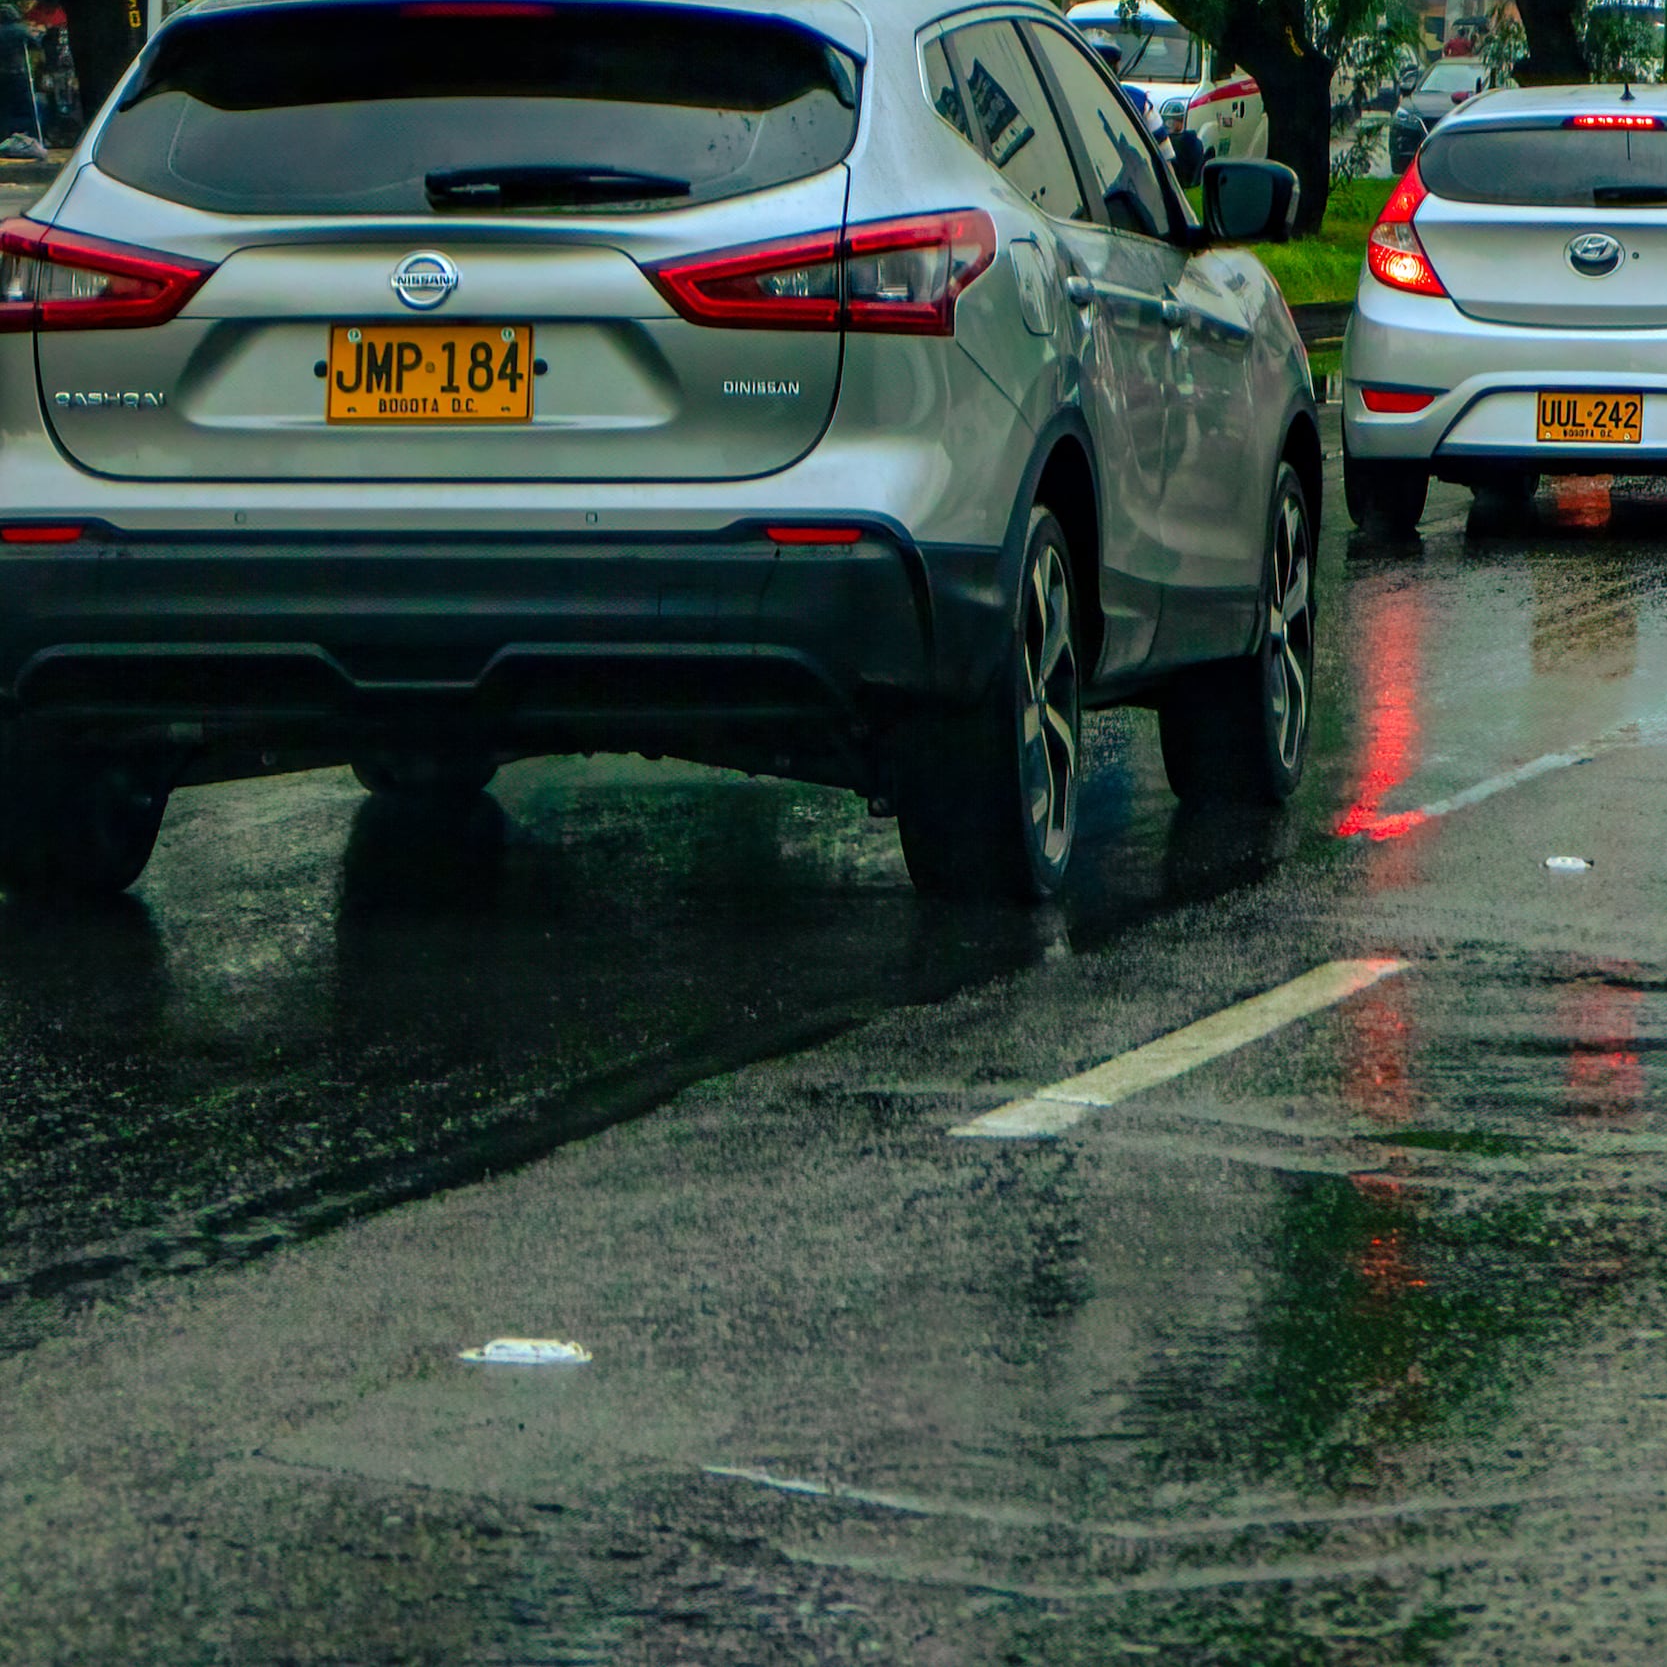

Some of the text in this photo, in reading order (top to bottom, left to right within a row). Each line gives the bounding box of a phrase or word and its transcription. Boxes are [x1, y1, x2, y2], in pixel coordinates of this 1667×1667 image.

[397, 275, 451, 285] NISSAN
[441, 341, 524, 393] 184
[723, 380, 800, 395] DINISSAN
[55, 392, 164, 409] QASHQAI
[378, 398, 439, 413] BOGOTA
[1541, 400, 1638, 428] UUL 242
